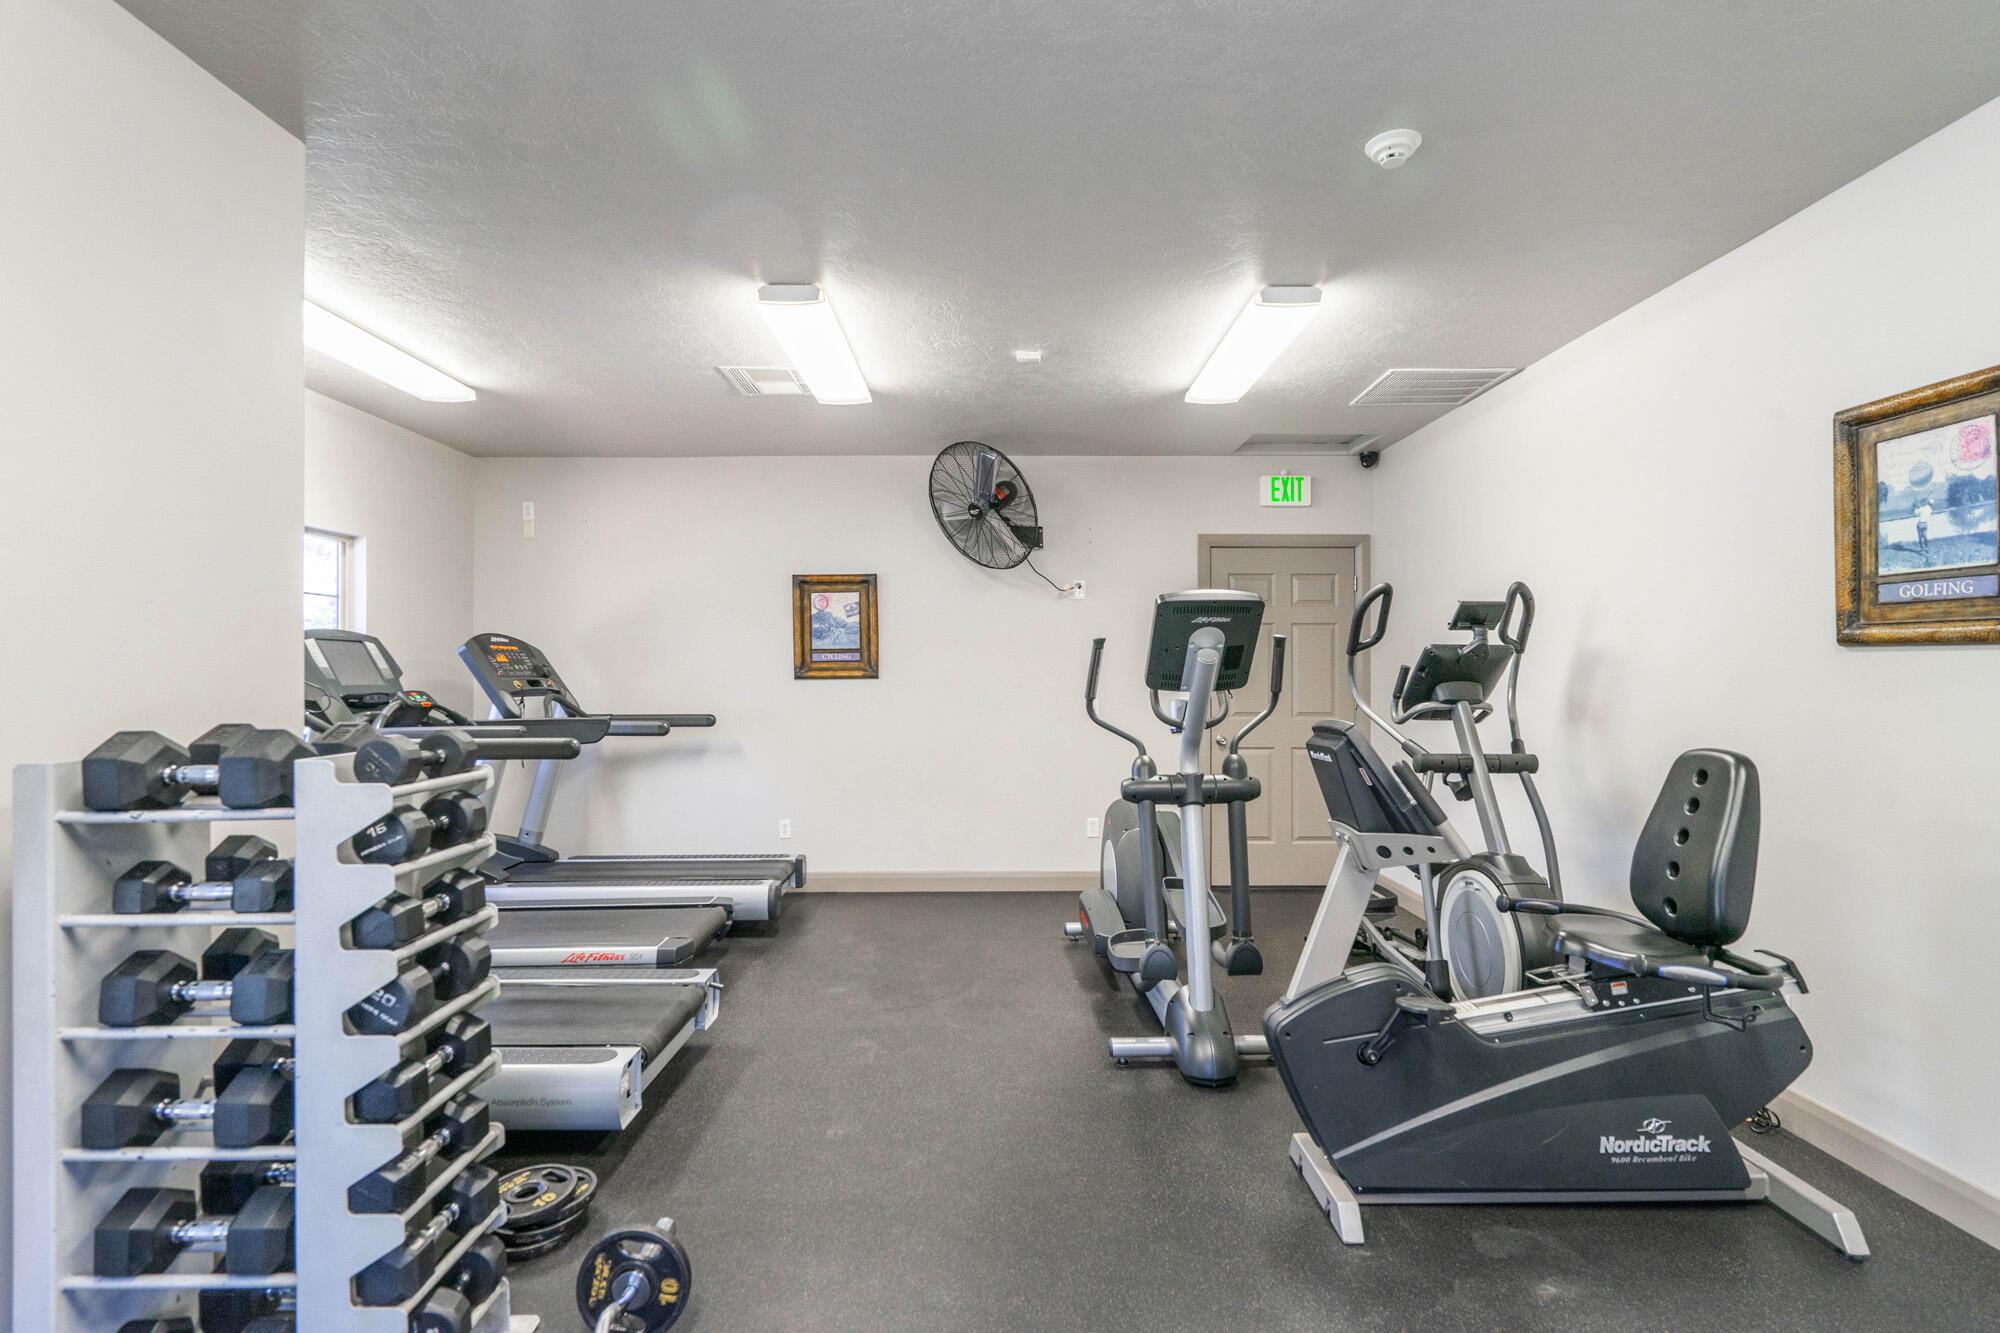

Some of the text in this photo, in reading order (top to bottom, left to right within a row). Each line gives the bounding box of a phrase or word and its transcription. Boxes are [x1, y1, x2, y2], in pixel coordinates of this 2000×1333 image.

[1271, 476, 1304, 502] EXIT
[1899, 580, 1974, 598] GOLFING
[540, 1098, 572, 1107] System
[1600, 1135, 1712, 1154] NordicTrack
[658, 1278, 679, 1307] 10
